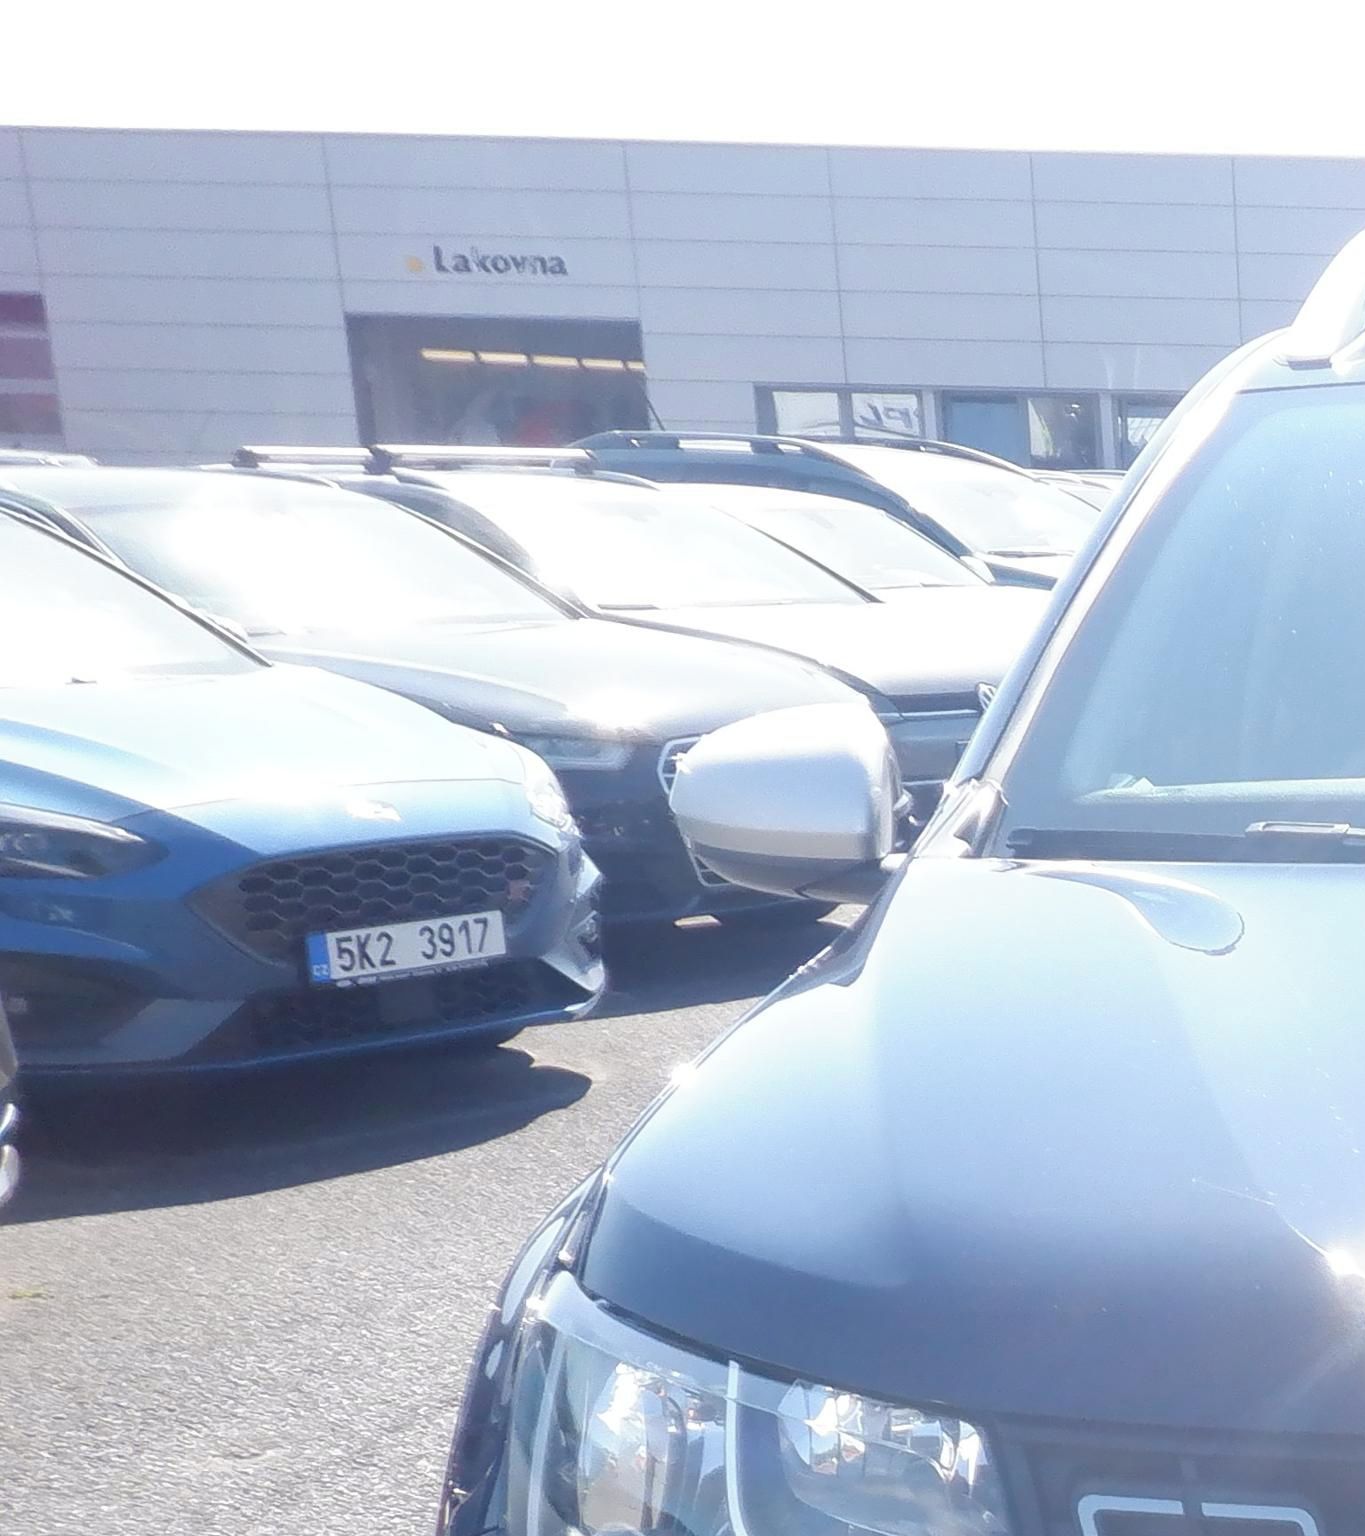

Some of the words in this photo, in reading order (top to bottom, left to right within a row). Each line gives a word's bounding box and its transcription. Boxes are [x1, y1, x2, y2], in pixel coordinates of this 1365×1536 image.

[433, 245, 568, 276] Lakovna
[335, 931, 396, 972] 5K2
[419, 917, 488, 960] 3917
